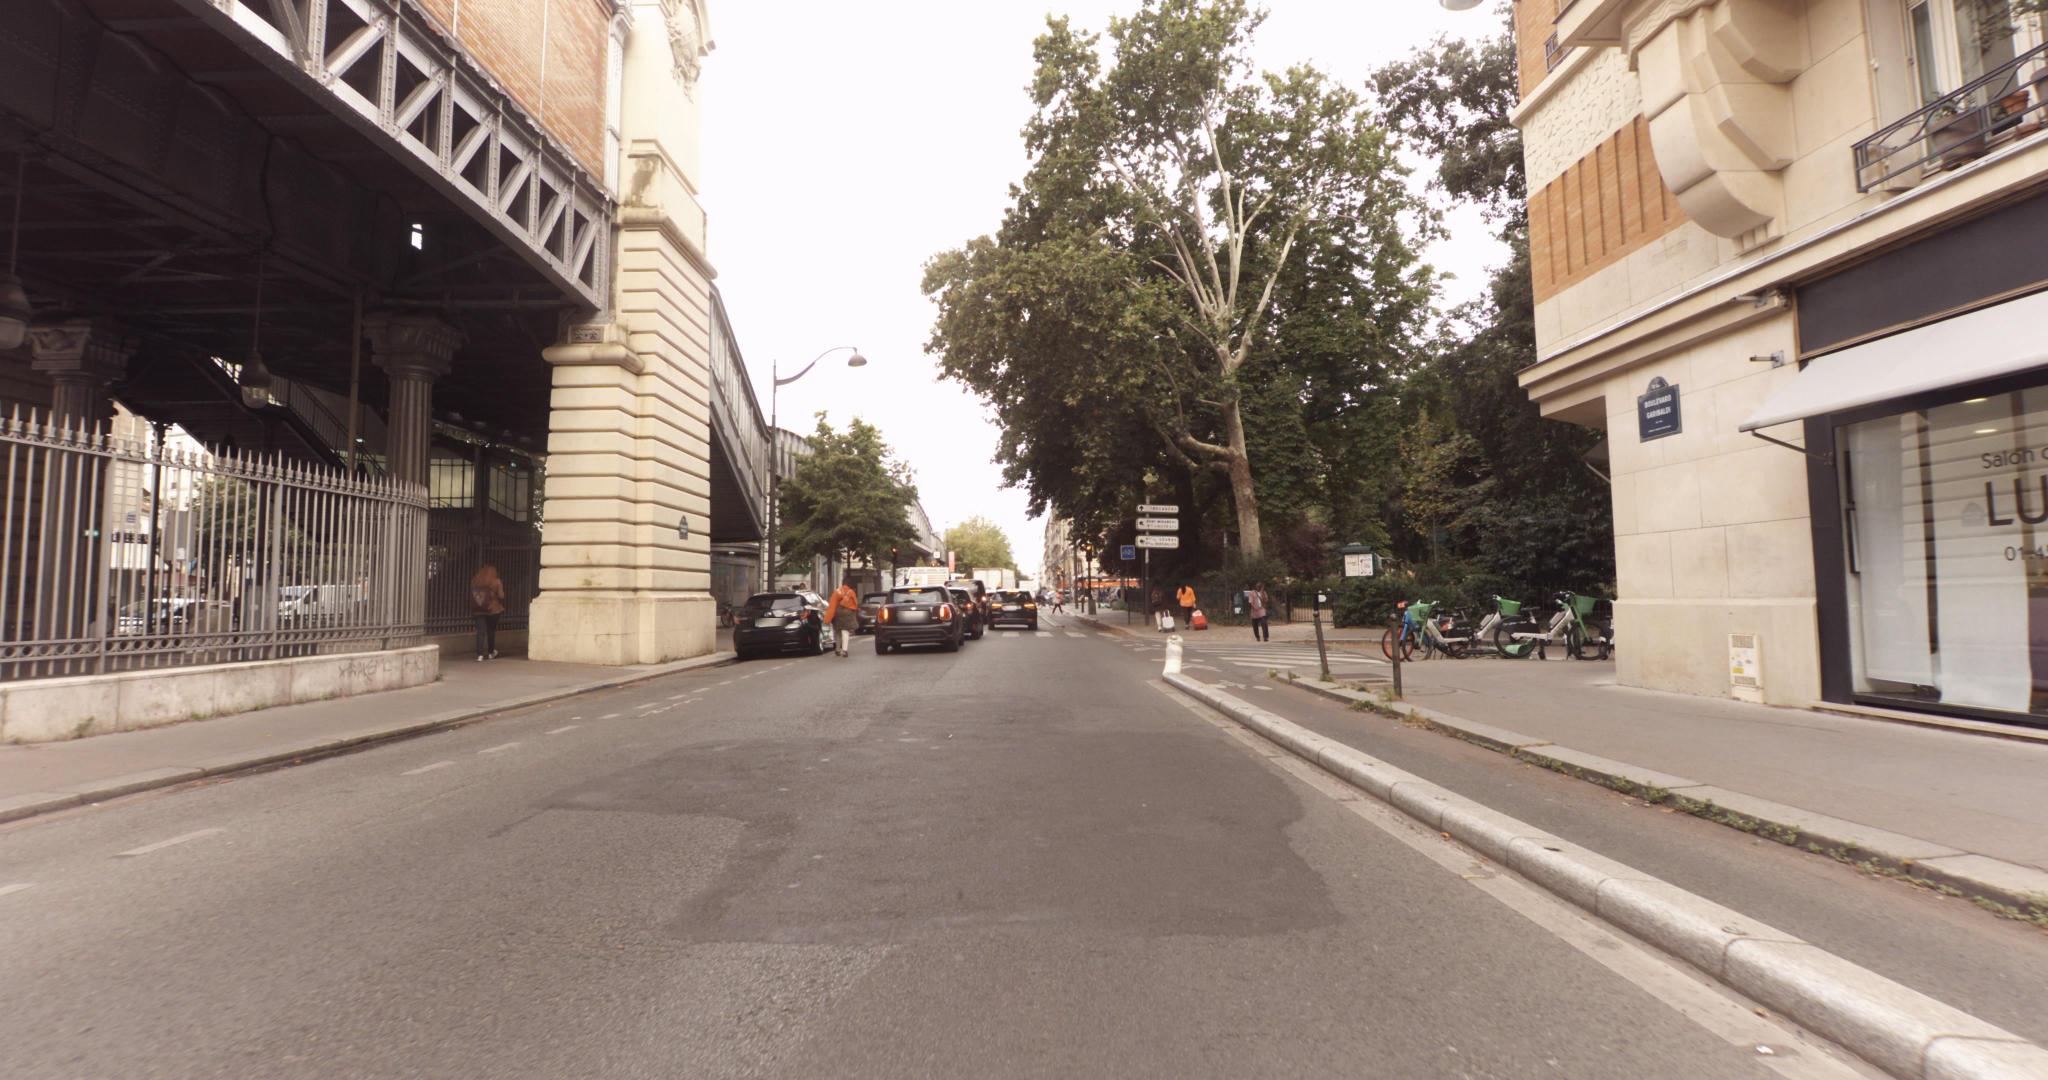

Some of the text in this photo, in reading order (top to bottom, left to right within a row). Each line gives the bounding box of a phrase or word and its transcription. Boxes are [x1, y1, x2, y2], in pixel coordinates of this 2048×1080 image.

[1644, 394, 1671, 408] BOULEVARD
[1646, 406, 1672, 419] GARIBALDI
[1982, 450, 2034, 469] Salon
